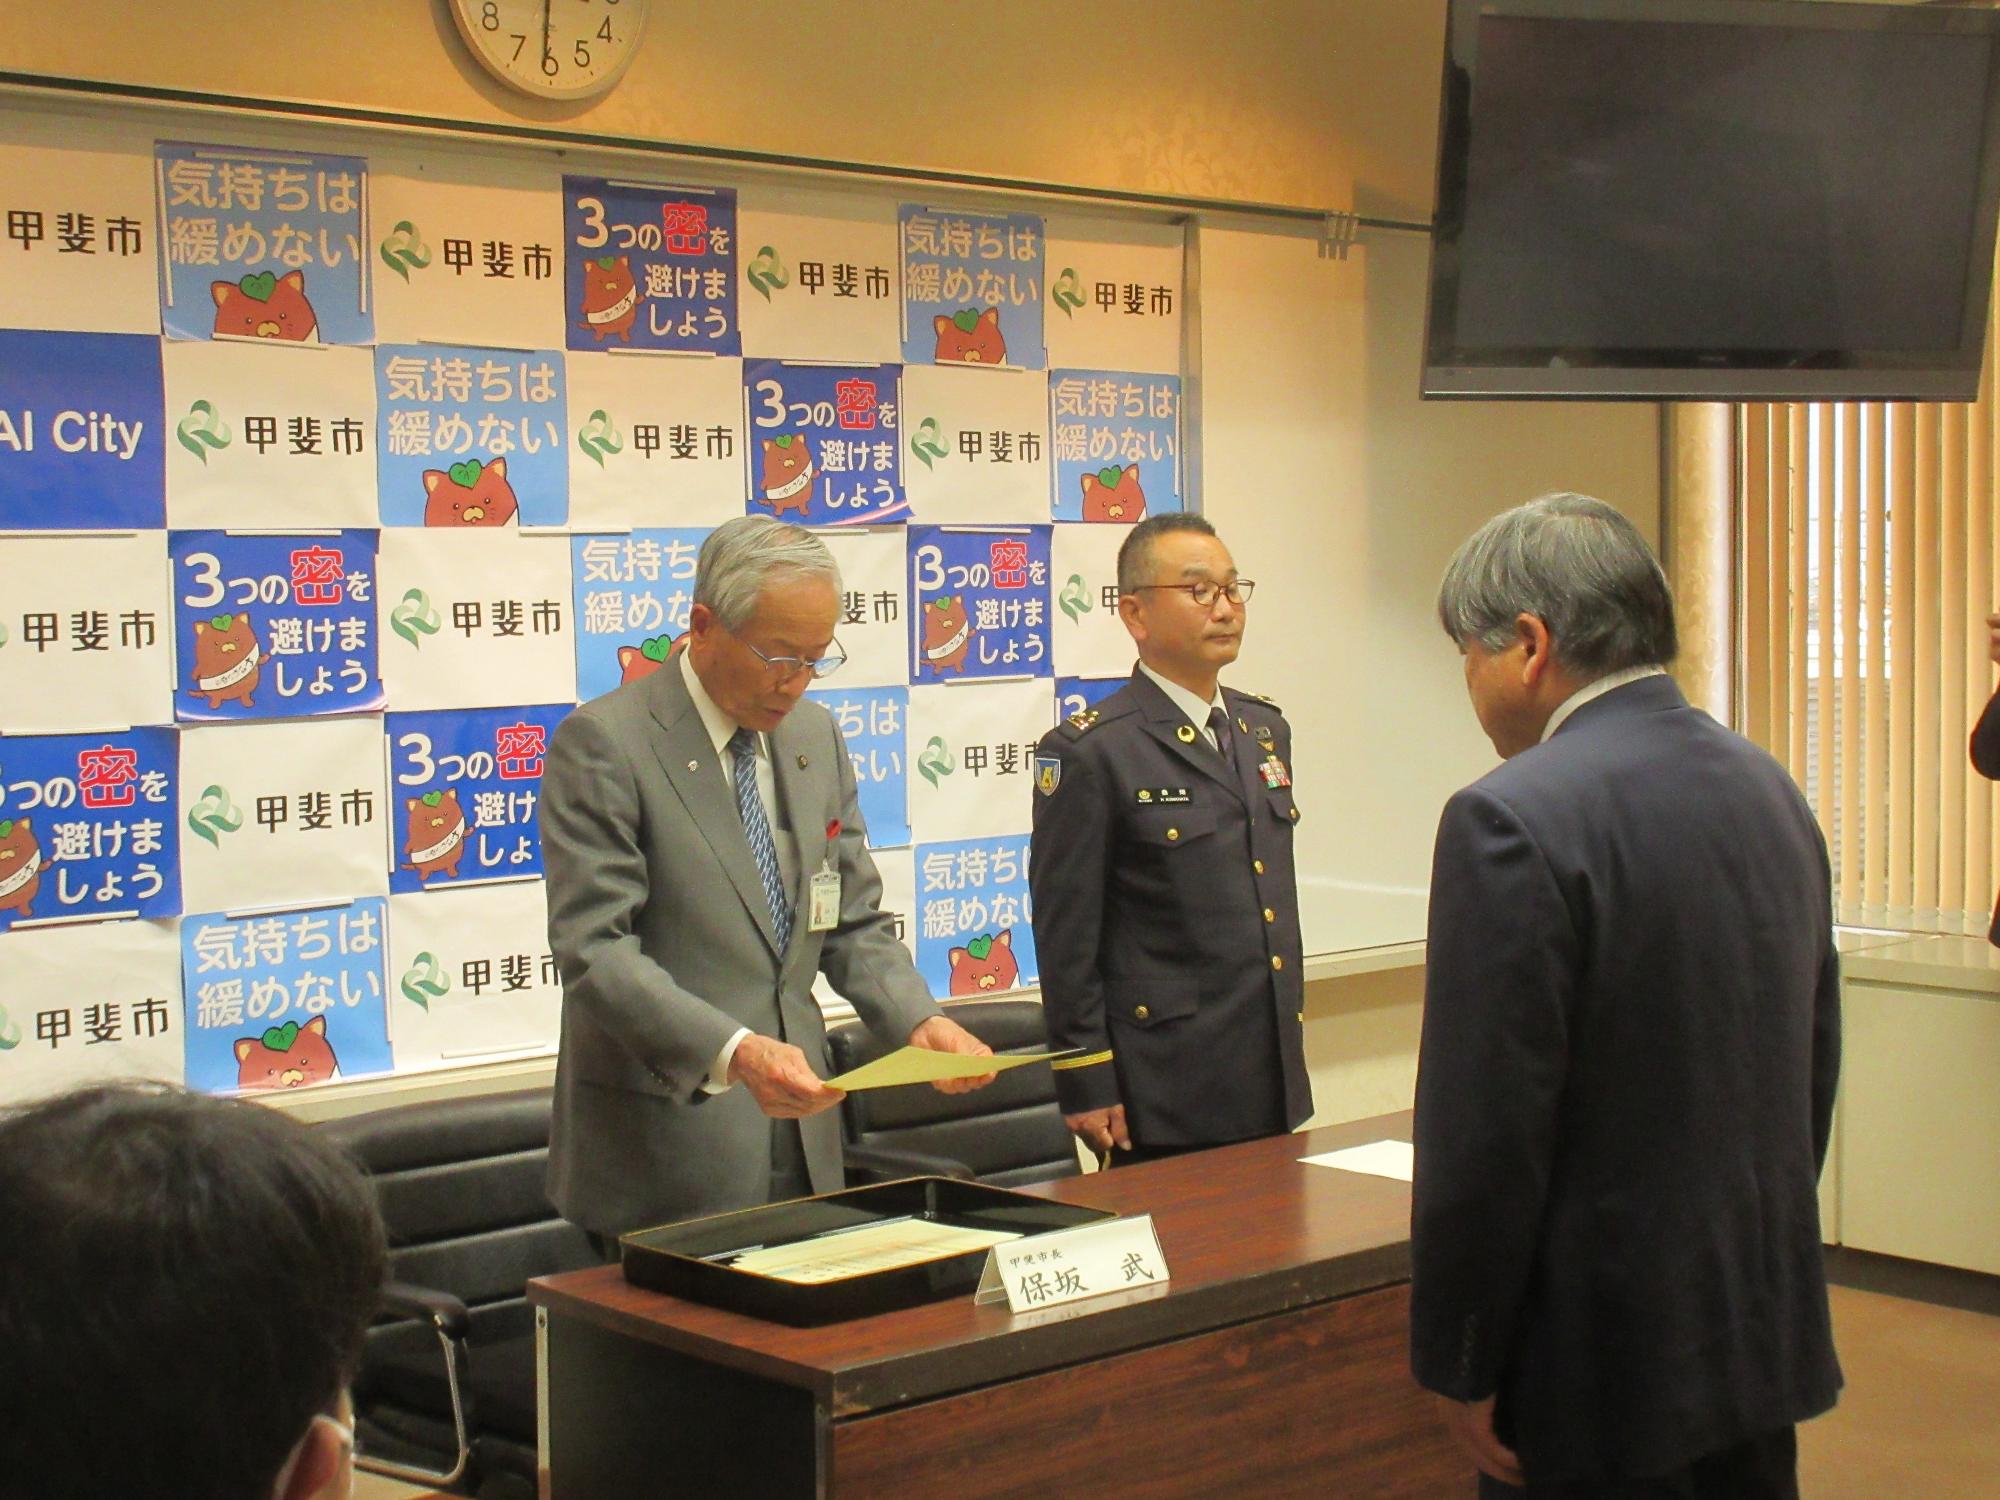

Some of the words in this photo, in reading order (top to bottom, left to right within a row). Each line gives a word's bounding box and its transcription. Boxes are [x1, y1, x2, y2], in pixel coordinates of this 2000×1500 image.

[482, 2, 500, 31] 8
[596, 15, 613, 44] 4
[510, 34, 527, 62] 7
[541, 47, 559, 76] 6
[574, 39, 591, 68] 5
[167, 159, 358, 214] 気持ちは
[7, 210, 142, 257] 甲斐市
[170, 215, 360, 267] 緩めない
[576, 197, 730, 256] 3つの密を
[905, 214, 1037, 262] 気持ちは
[443, 238, 552, 280] 甲斐市
[644, 263, 727, 300] 避けま
[799, 261, 890, 300] 甲斐市
[905, 262, 1038, 307] 緩めない
[1095, 281, 1173, 317] 甲斐市
[649, 304, 727, 339] しょう
[385, 355, 557, 403] 気持ちは
[1055, 377, 1173, 420] 気持ちは
[755, 378, 897, 431] 3つの密を
[52, 410, 144, 460] City
[244, 416, 364, 456] 甲斐市
[387, 409, 559, 457] 緩めない
[633, 424, 734, 460] 甲斐市
[958, 430, 1041, 464] 甲斐市
[1056, 423, 1175, 463] 緩めない
[820, 440, 894, 473] 避けま
[825, 476, 895, 509] しょう
[184, 545, 371, 608] 3つの密を
[917, 538, 1046, 591] 3つの密を
[23, 609, 156, 653] 甲斐市
[452, 599, 561, 638] 甲斐市
[975, 597, 1044, 631] 避けま
[269, 616, 367, 656] 避けま
[979, 633, 1045, 665] しょう
[276, 660, 368, 697] しょう
[817, 698, 901, 739] ちは
[398, 721, 546, 786] 3つの密
[0, 744, 169, 811] つの密を
[255, 788, 374, 834] 甲斐市
[52, 817, 164, 863] 避けま
[479, 834, 542, 867] しょ
[58, 863, 164, 905] しょう
[192, 910, 379, 973] 気持ちは
[197, 969, 381, 1030] 緩めない
[36, 997, 169, 1050] 甲斐市
[1019, 1266, 1090, 1305] 保坂
[1120, 1251, 1155, 1283] 武
